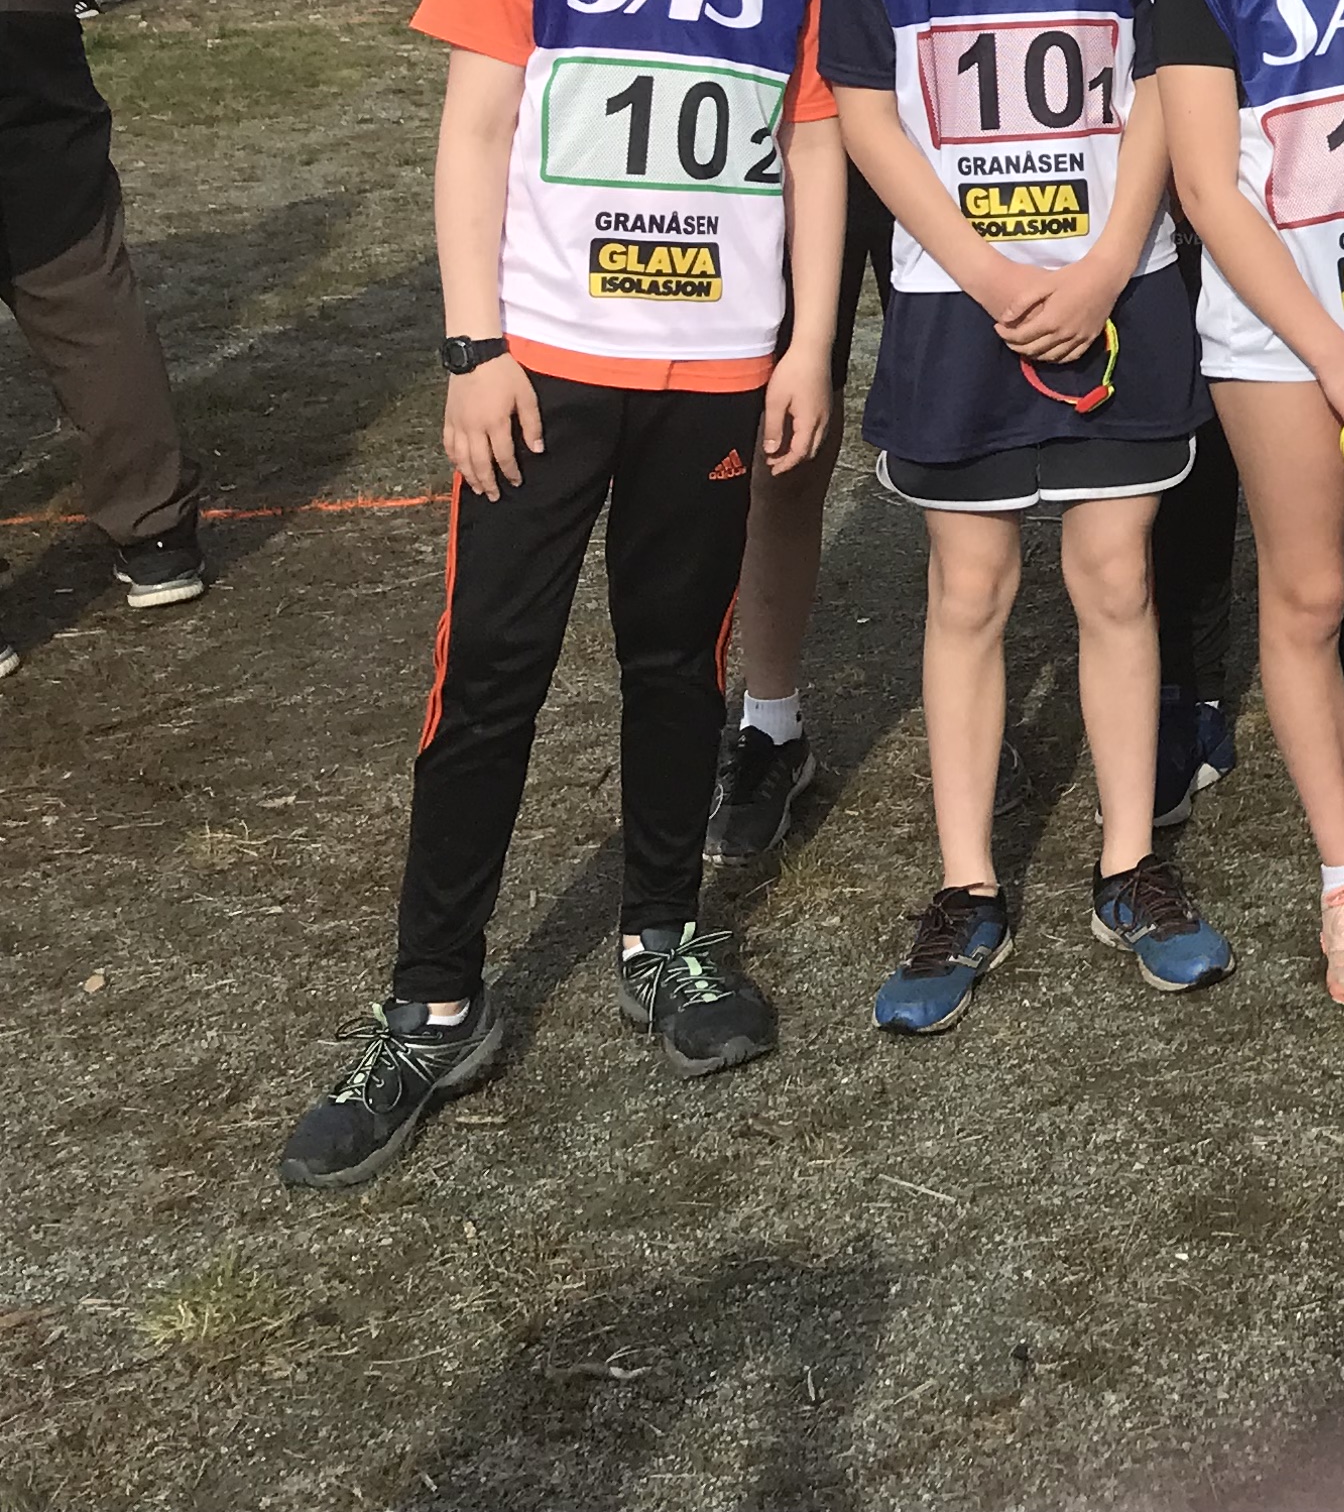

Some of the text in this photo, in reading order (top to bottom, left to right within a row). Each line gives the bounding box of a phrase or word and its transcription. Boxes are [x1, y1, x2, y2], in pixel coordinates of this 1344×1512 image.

[957, 30, 1114, 131] 10 1
[605, 75, 780, 185] 10 2
[957, 150, 1084, 176] GRANÅSEN
[965, 185, 1080, 216] GLAVA
[595, 210, 719, 237] GRANÅSEN
[599, 242, 717, 276] GLAVA
[601, 276, 712, 298] ISOLASJON
